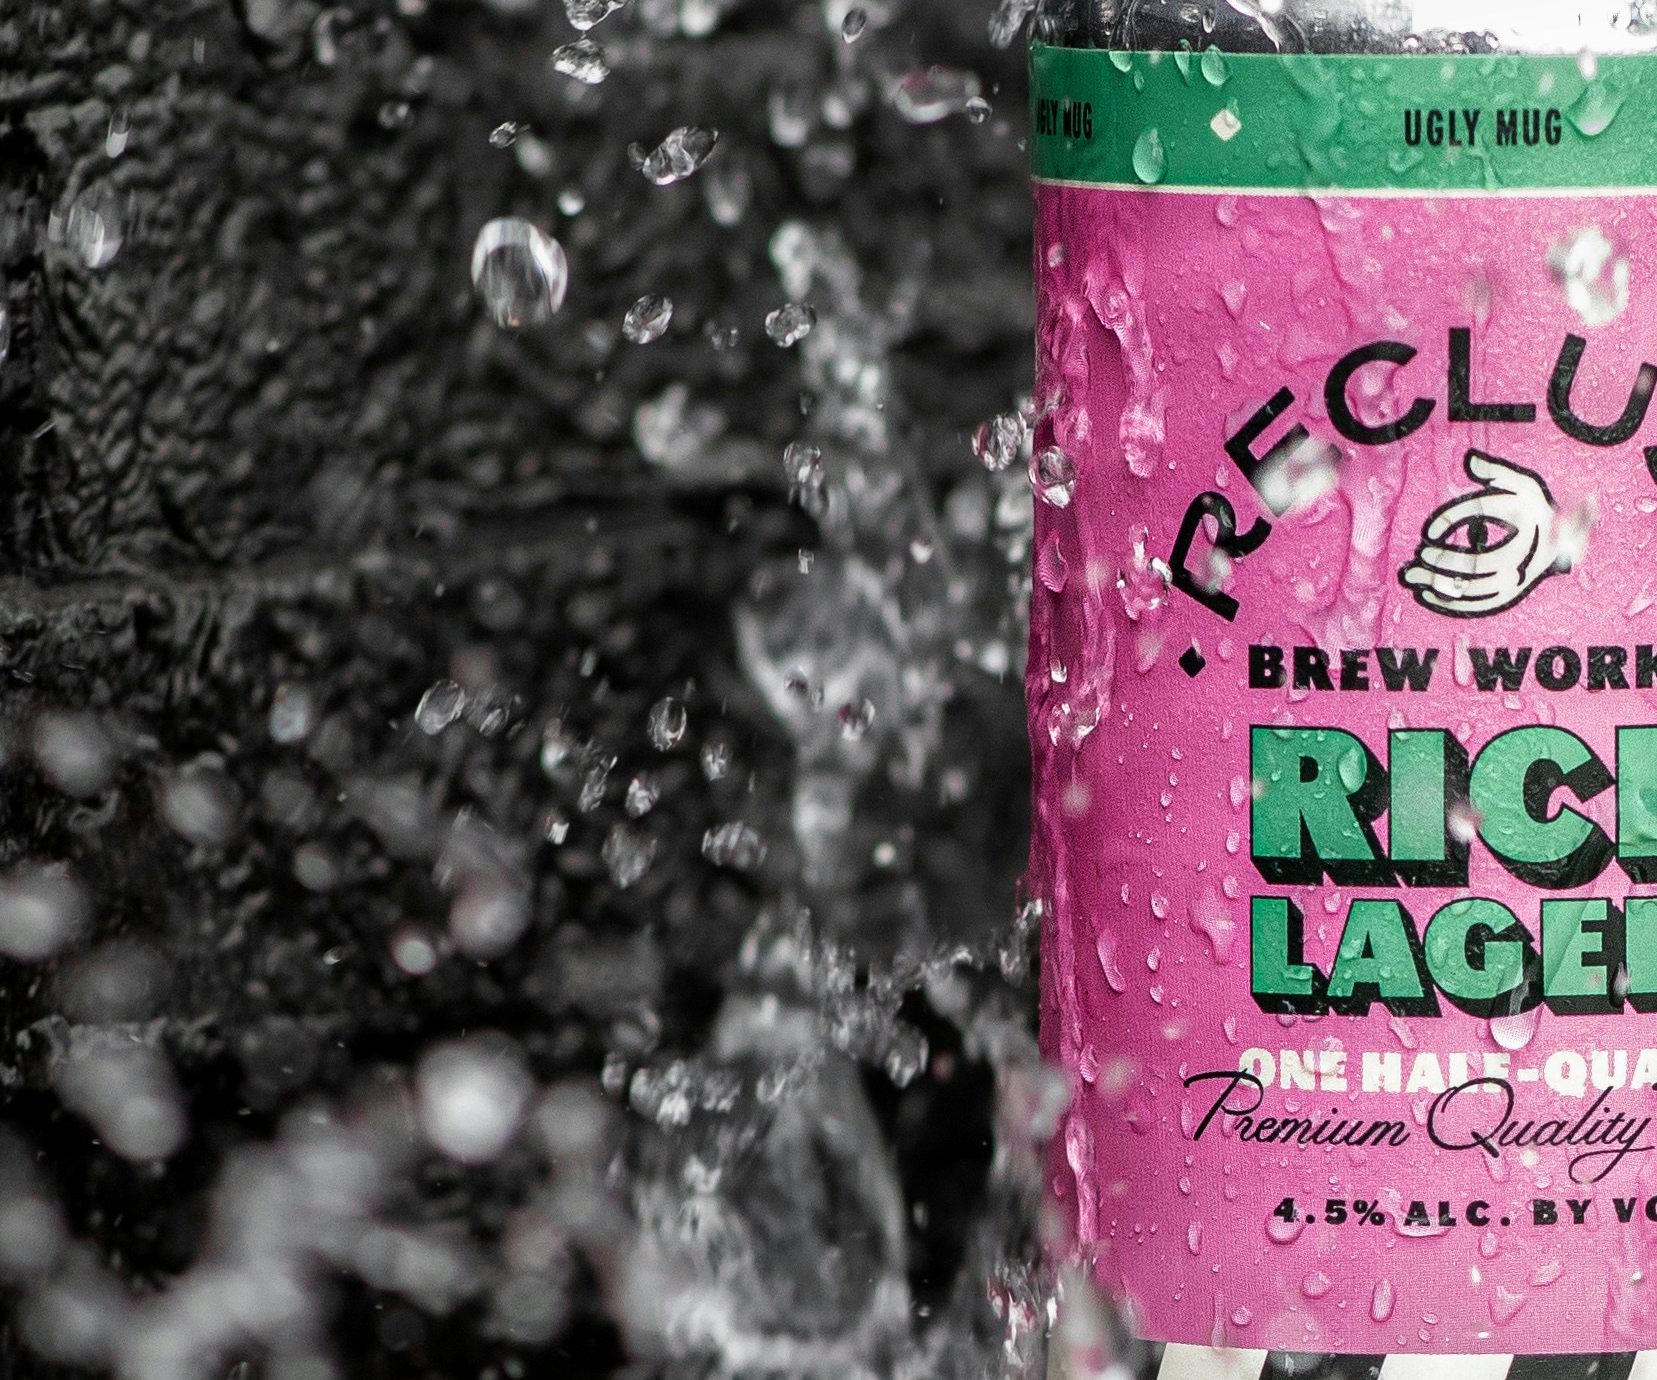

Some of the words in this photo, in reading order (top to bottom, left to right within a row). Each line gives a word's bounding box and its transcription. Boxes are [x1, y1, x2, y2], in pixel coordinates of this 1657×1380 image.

[1063, 99, 1093, 140] MUG
[1404, 108, 1480, 146] UGLY
[1496, 108, 1562, 146] MUG
[1248, 644, 1439, 692] BREW
[1238, 1047, 1348, 1093] ONE
[1183, 1068, 1411, 1147] Premium
[1427, 1076, 1656, 1185] Quality
[1273, 1197, 1386, 1226] 4.5%
[1404, 1200, 1510, 1227] ALC.
[1533, 1198, 1592, 1225] BY
